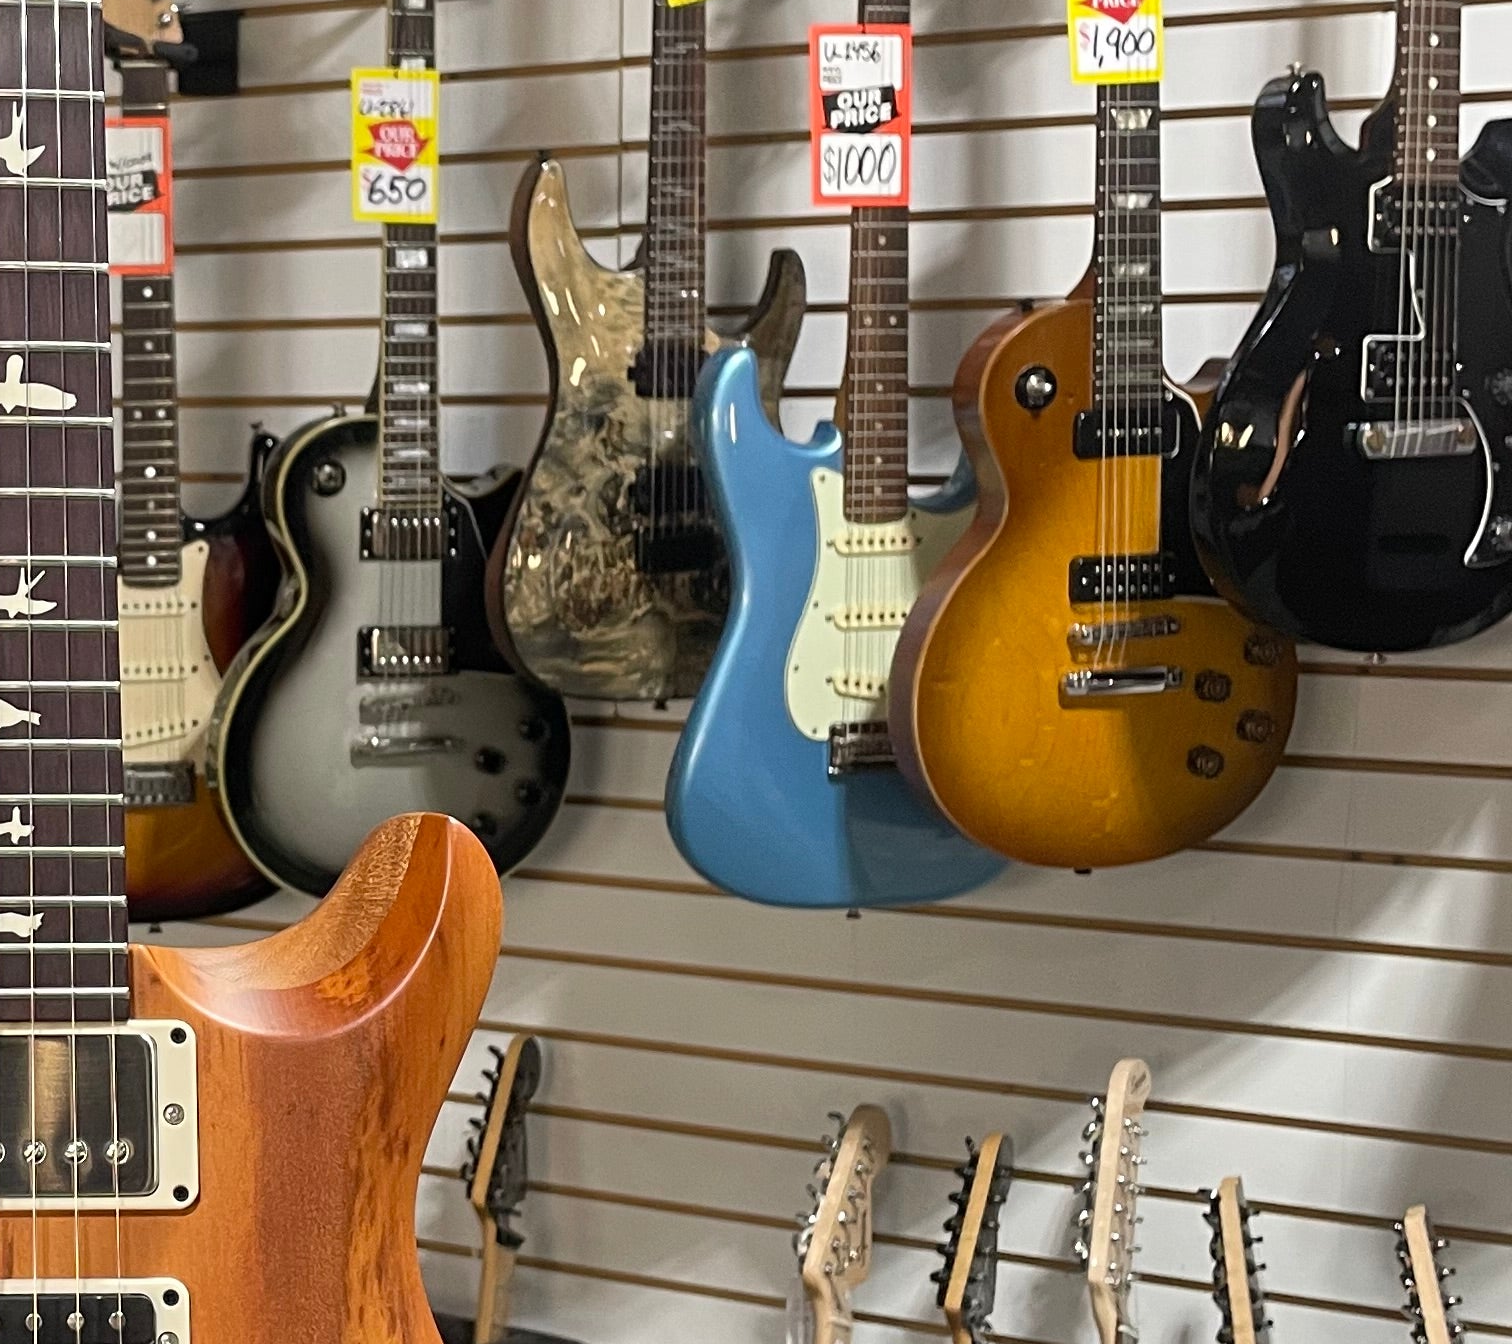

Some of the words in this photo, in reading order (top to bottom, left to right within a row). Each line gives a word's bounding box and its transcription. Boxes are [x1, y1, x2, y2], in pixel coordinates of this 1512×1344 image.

[837, 88, 882, 110] OUR
[829, 101, 893, 130] PRICE
[823, 142, 897, 191] $1000
[107, 186, 155, 207] RICE
